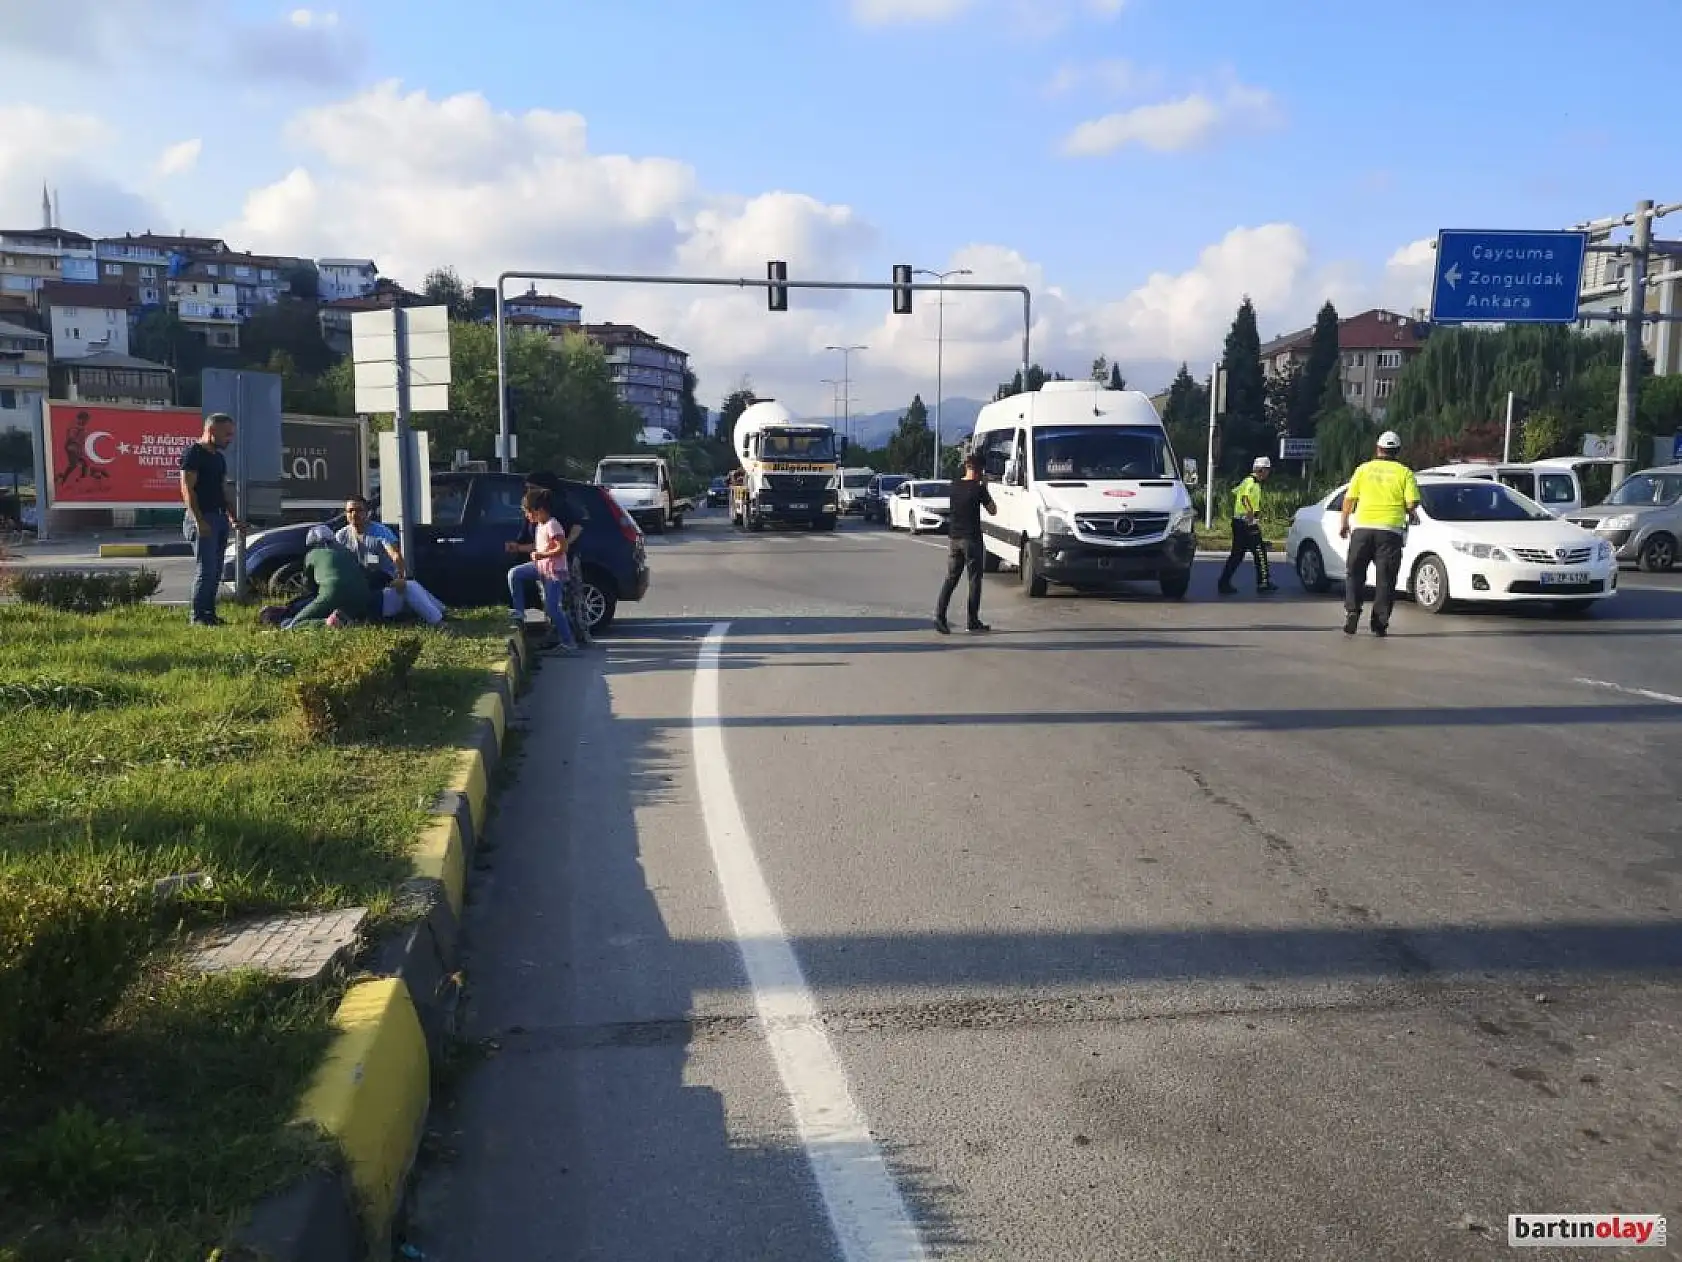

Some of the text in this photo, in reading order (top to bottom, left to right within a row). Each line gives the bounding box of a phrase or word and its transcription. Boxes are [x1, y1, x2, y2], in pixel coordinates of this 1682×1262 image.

[1468, 270, 1564, 288] Zonguldak
[1466, 294, 1532, 308] Ankara
[141, 434, 154, 444] 30
[132, 444, 165, 455] ZAFER
[138, 455, 173, 467] KUTLU
